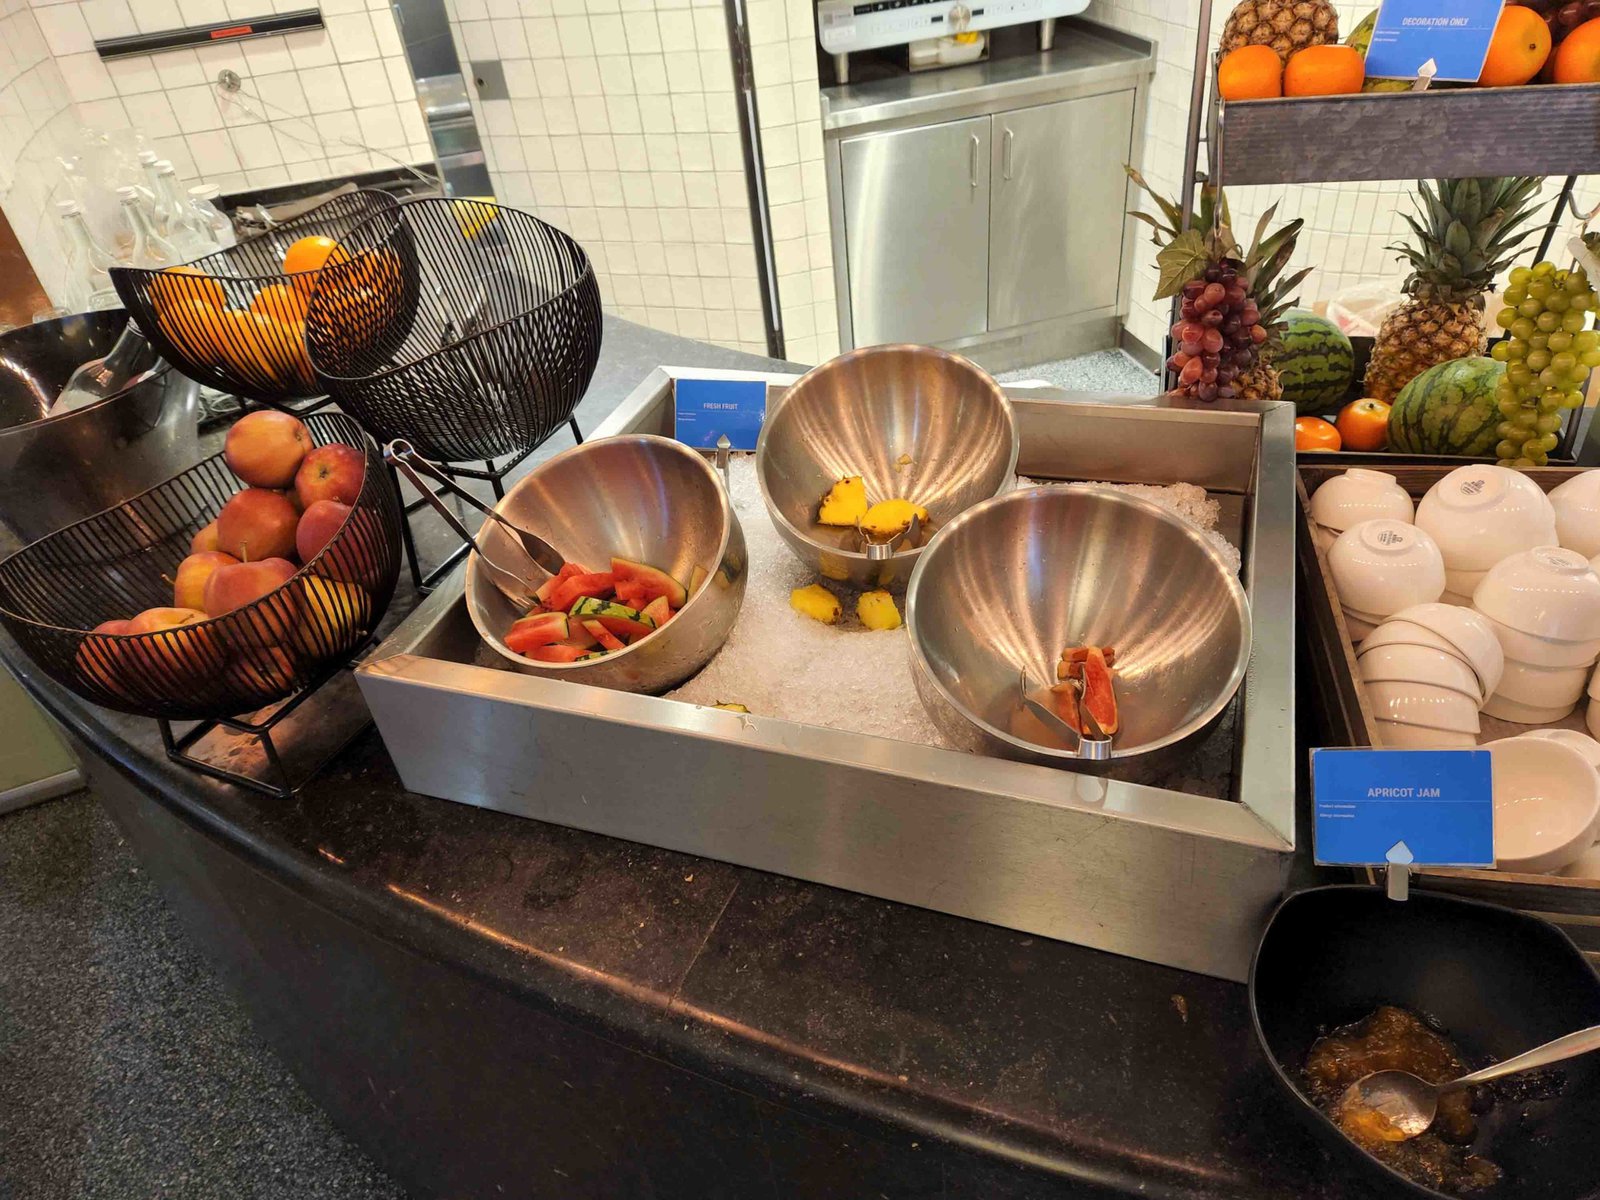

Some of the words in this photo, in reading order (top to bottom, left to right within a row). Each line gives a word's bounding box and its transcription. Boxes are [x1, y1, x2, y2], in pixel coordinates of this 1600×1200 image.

[1402, 17, 1449, 26] DECORATION
[1450, 17, 1470, 26] ONLY
[1367, 788, 1414, 798] APRICOT
[1416, 788, 1440, 798] JAM
